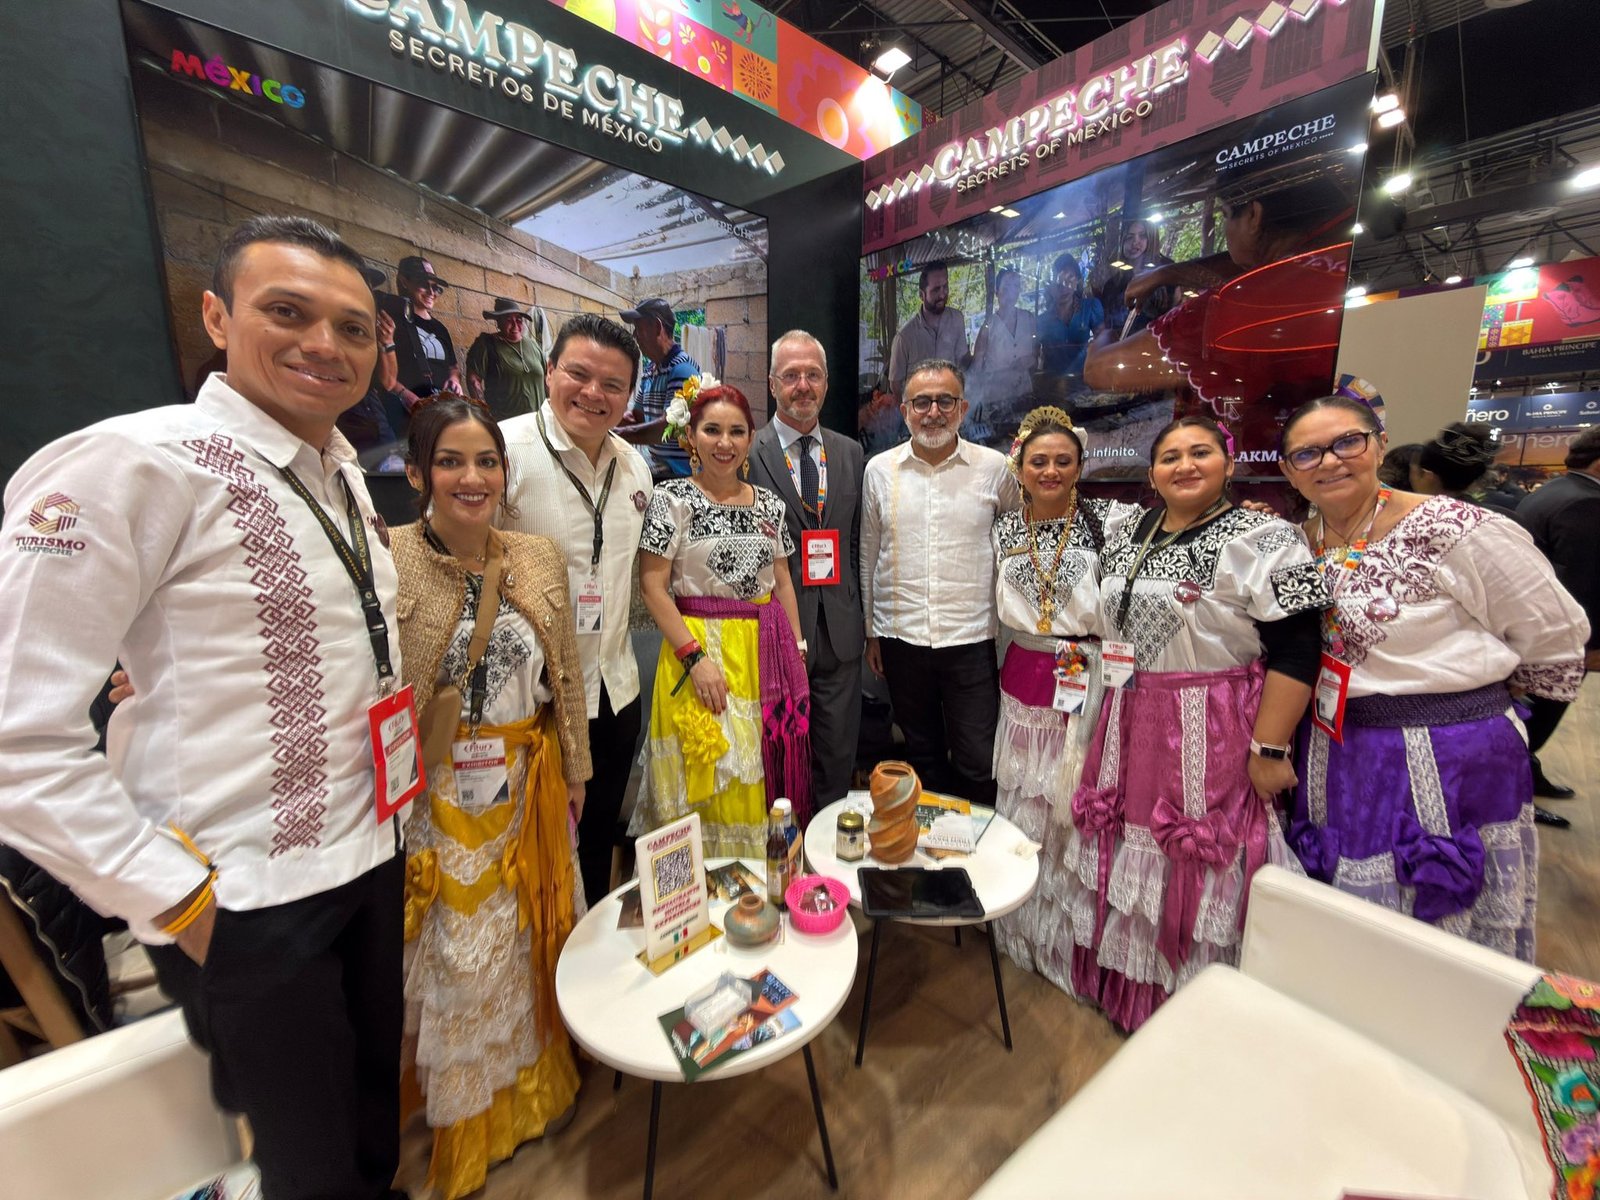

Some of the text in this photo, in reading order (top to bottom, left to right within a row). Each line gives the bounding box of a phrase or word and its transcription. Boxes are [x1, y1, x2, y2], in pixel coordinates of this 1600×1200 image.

[345, 0, 689, 141] AMPECHE
[389, 29, 663, 154] SECRETOS DE MÉXICO
[932, 38, 1189, 183] CAMPECHE
[957, 100, 1153, 193] SECRETS OF MEXICO
[1215, 114, 1337, 165] CAMPECHE
[1228, 136, 1318, 170] SECRETS OF MEXICO
[1093, 446, 1138, 457] infinito.
[15, 536, 86, 551] TURISMO
[18, 546, 74, 556] CAMPECHE
[647, 825, 692, 851] CAMPECHE
